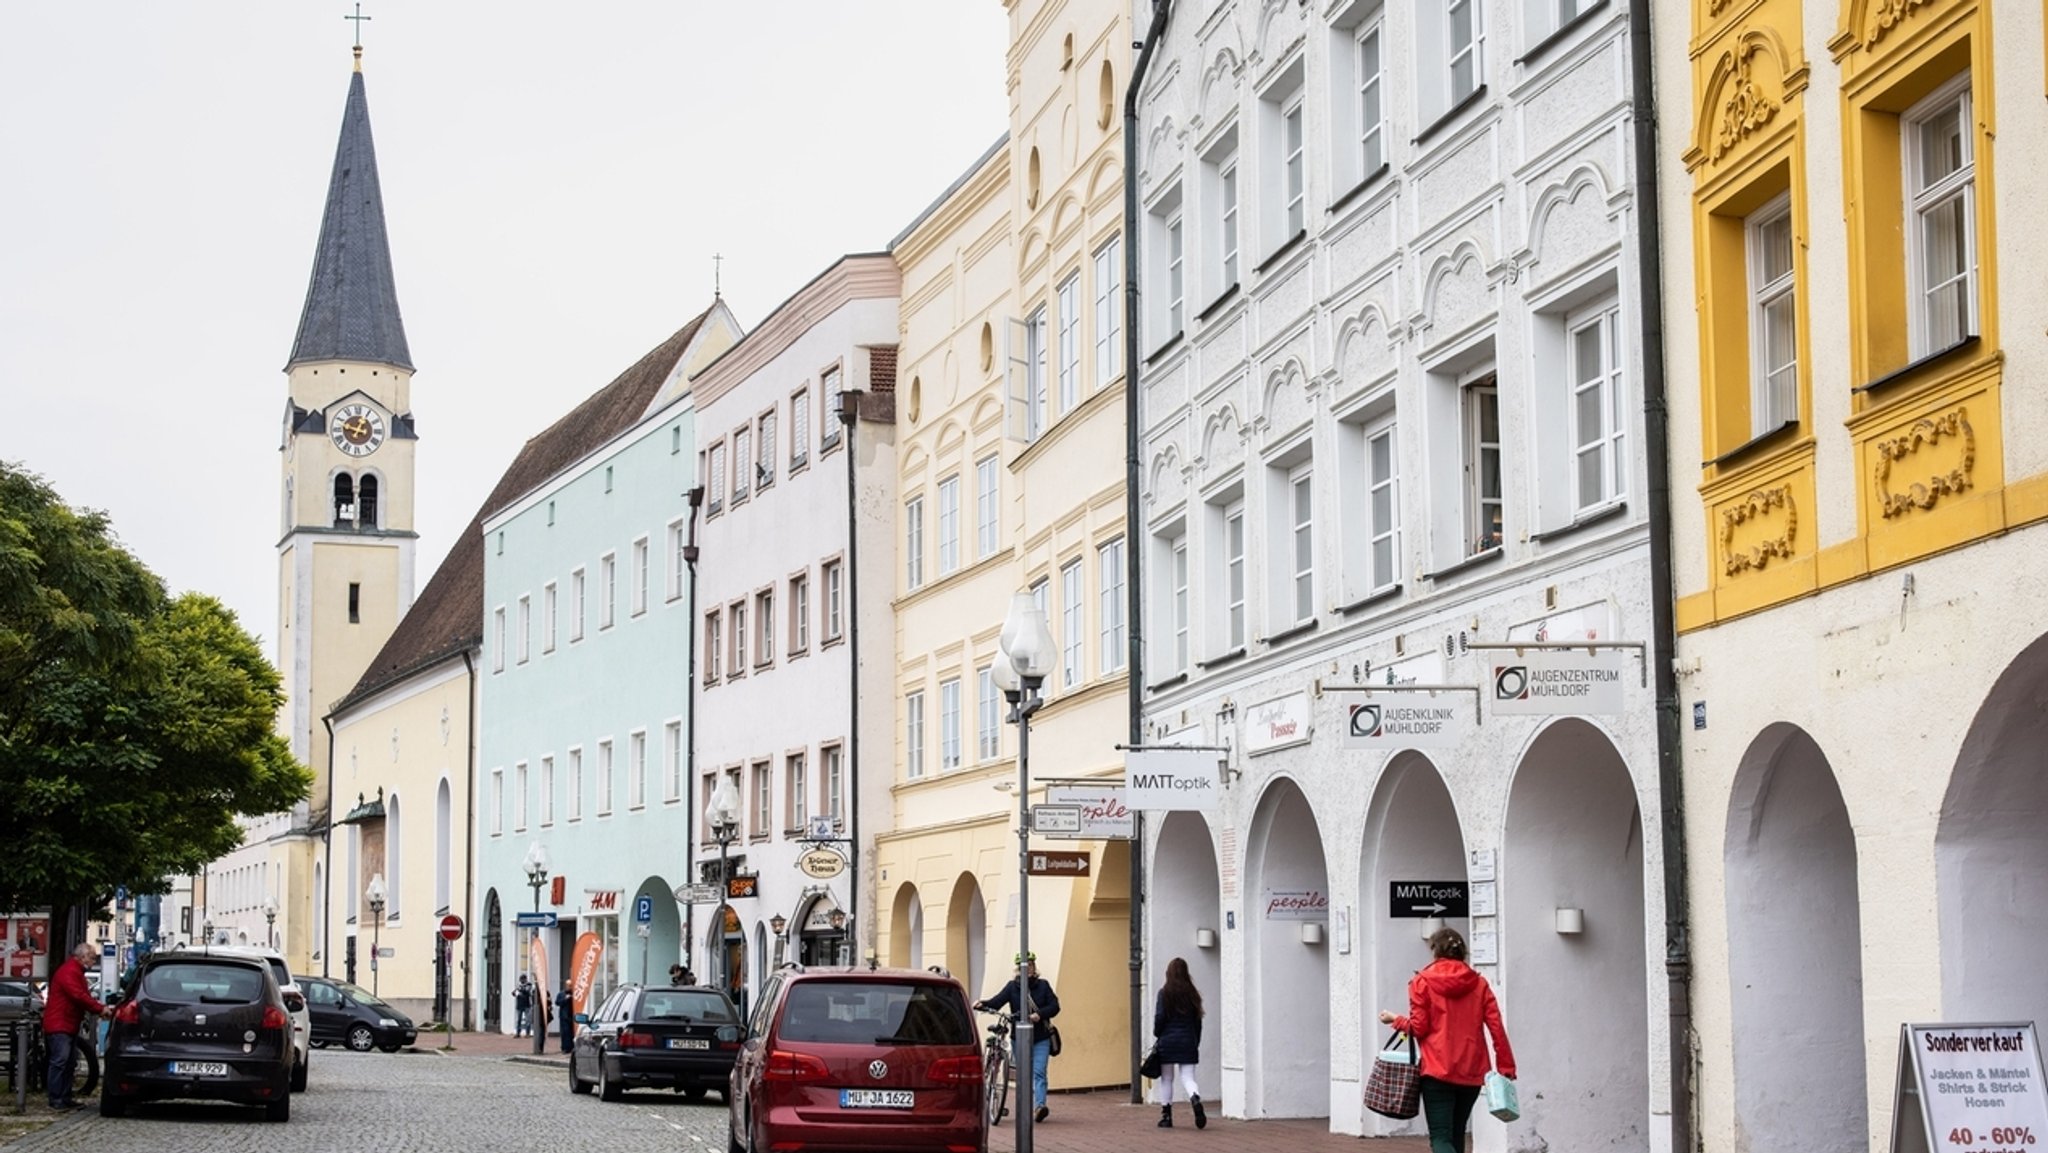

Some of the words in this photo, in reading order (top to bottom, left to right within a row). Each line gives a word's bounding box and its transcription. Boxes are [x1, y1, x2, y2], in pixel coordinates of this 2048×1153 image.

[1531, 669, 1619, 682] AUGENZENTRUM
[1531, 682, 1590, 696] MÜHLDORF
[1385, 708, 1455, 720] AUGENKLINIK
[1385, 720, 1443, 734] MÜHLDORF
[1133, 774, 1212, 792] MATToptik
[1397, 885, 1462, 900] MATToptik
[592, 892, 617, 910] H&M
[1267, 891, 1329, 914] people
[640, 901, 649, 919] P
[1925, 1031, 2023, 1053] Sonderverkauf
[1930, 1068, 1974, 1080] Jacken
[1977, 1068, 1986, 1079] &
[1989, 1067, 2030, 1079] Mäntel
[1938, 1082, 1975, 1094] Shirts
[1978, 1082, 1988, 1093] &
[1990, 1081, 2028, 1093] Strick
[870, 1092, 884, 1104] JA
[886, 1092, 913, 1105] 1622
[1965, 1096, 2005, 1108] Hosen
[1949, 1127, 1973, 1145] 40
[1991, 1126, 2036, 1145] 60%
